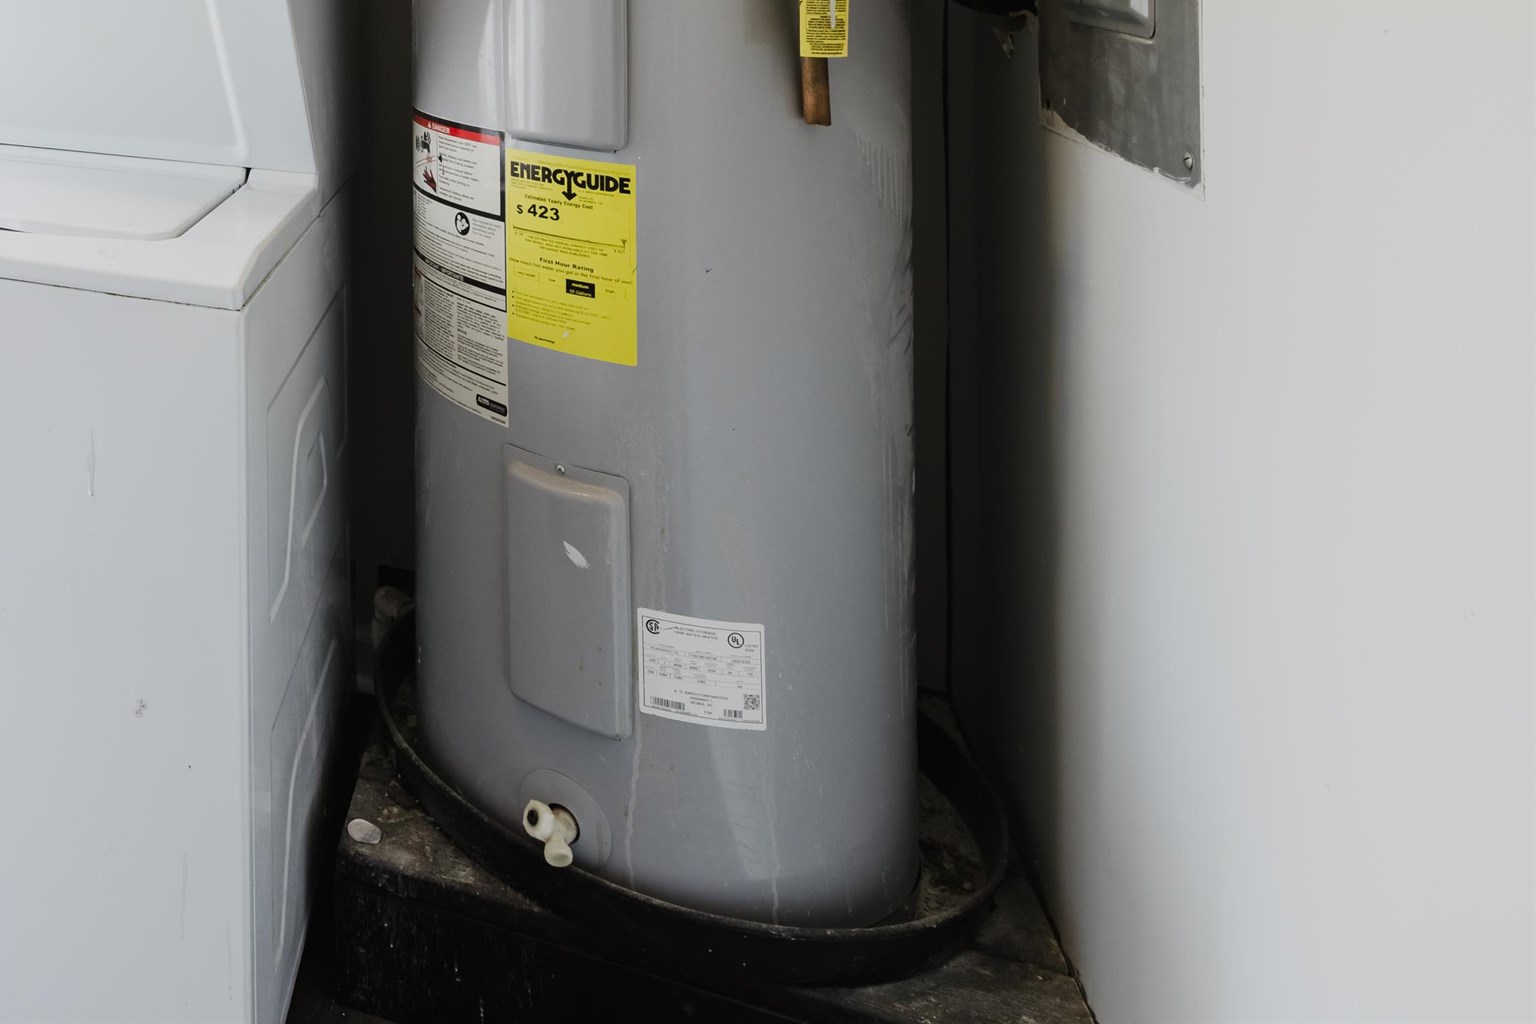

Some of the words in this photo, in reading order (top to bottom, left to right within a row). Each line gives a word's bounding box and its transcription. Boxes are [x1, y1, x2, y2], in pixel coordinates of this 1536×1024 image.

[564, 200, 581, 209] Energy
[516, 204, 523, 214] $
[527, 204, 560, 221] 423
[572, 264, 594, 273] Rating
